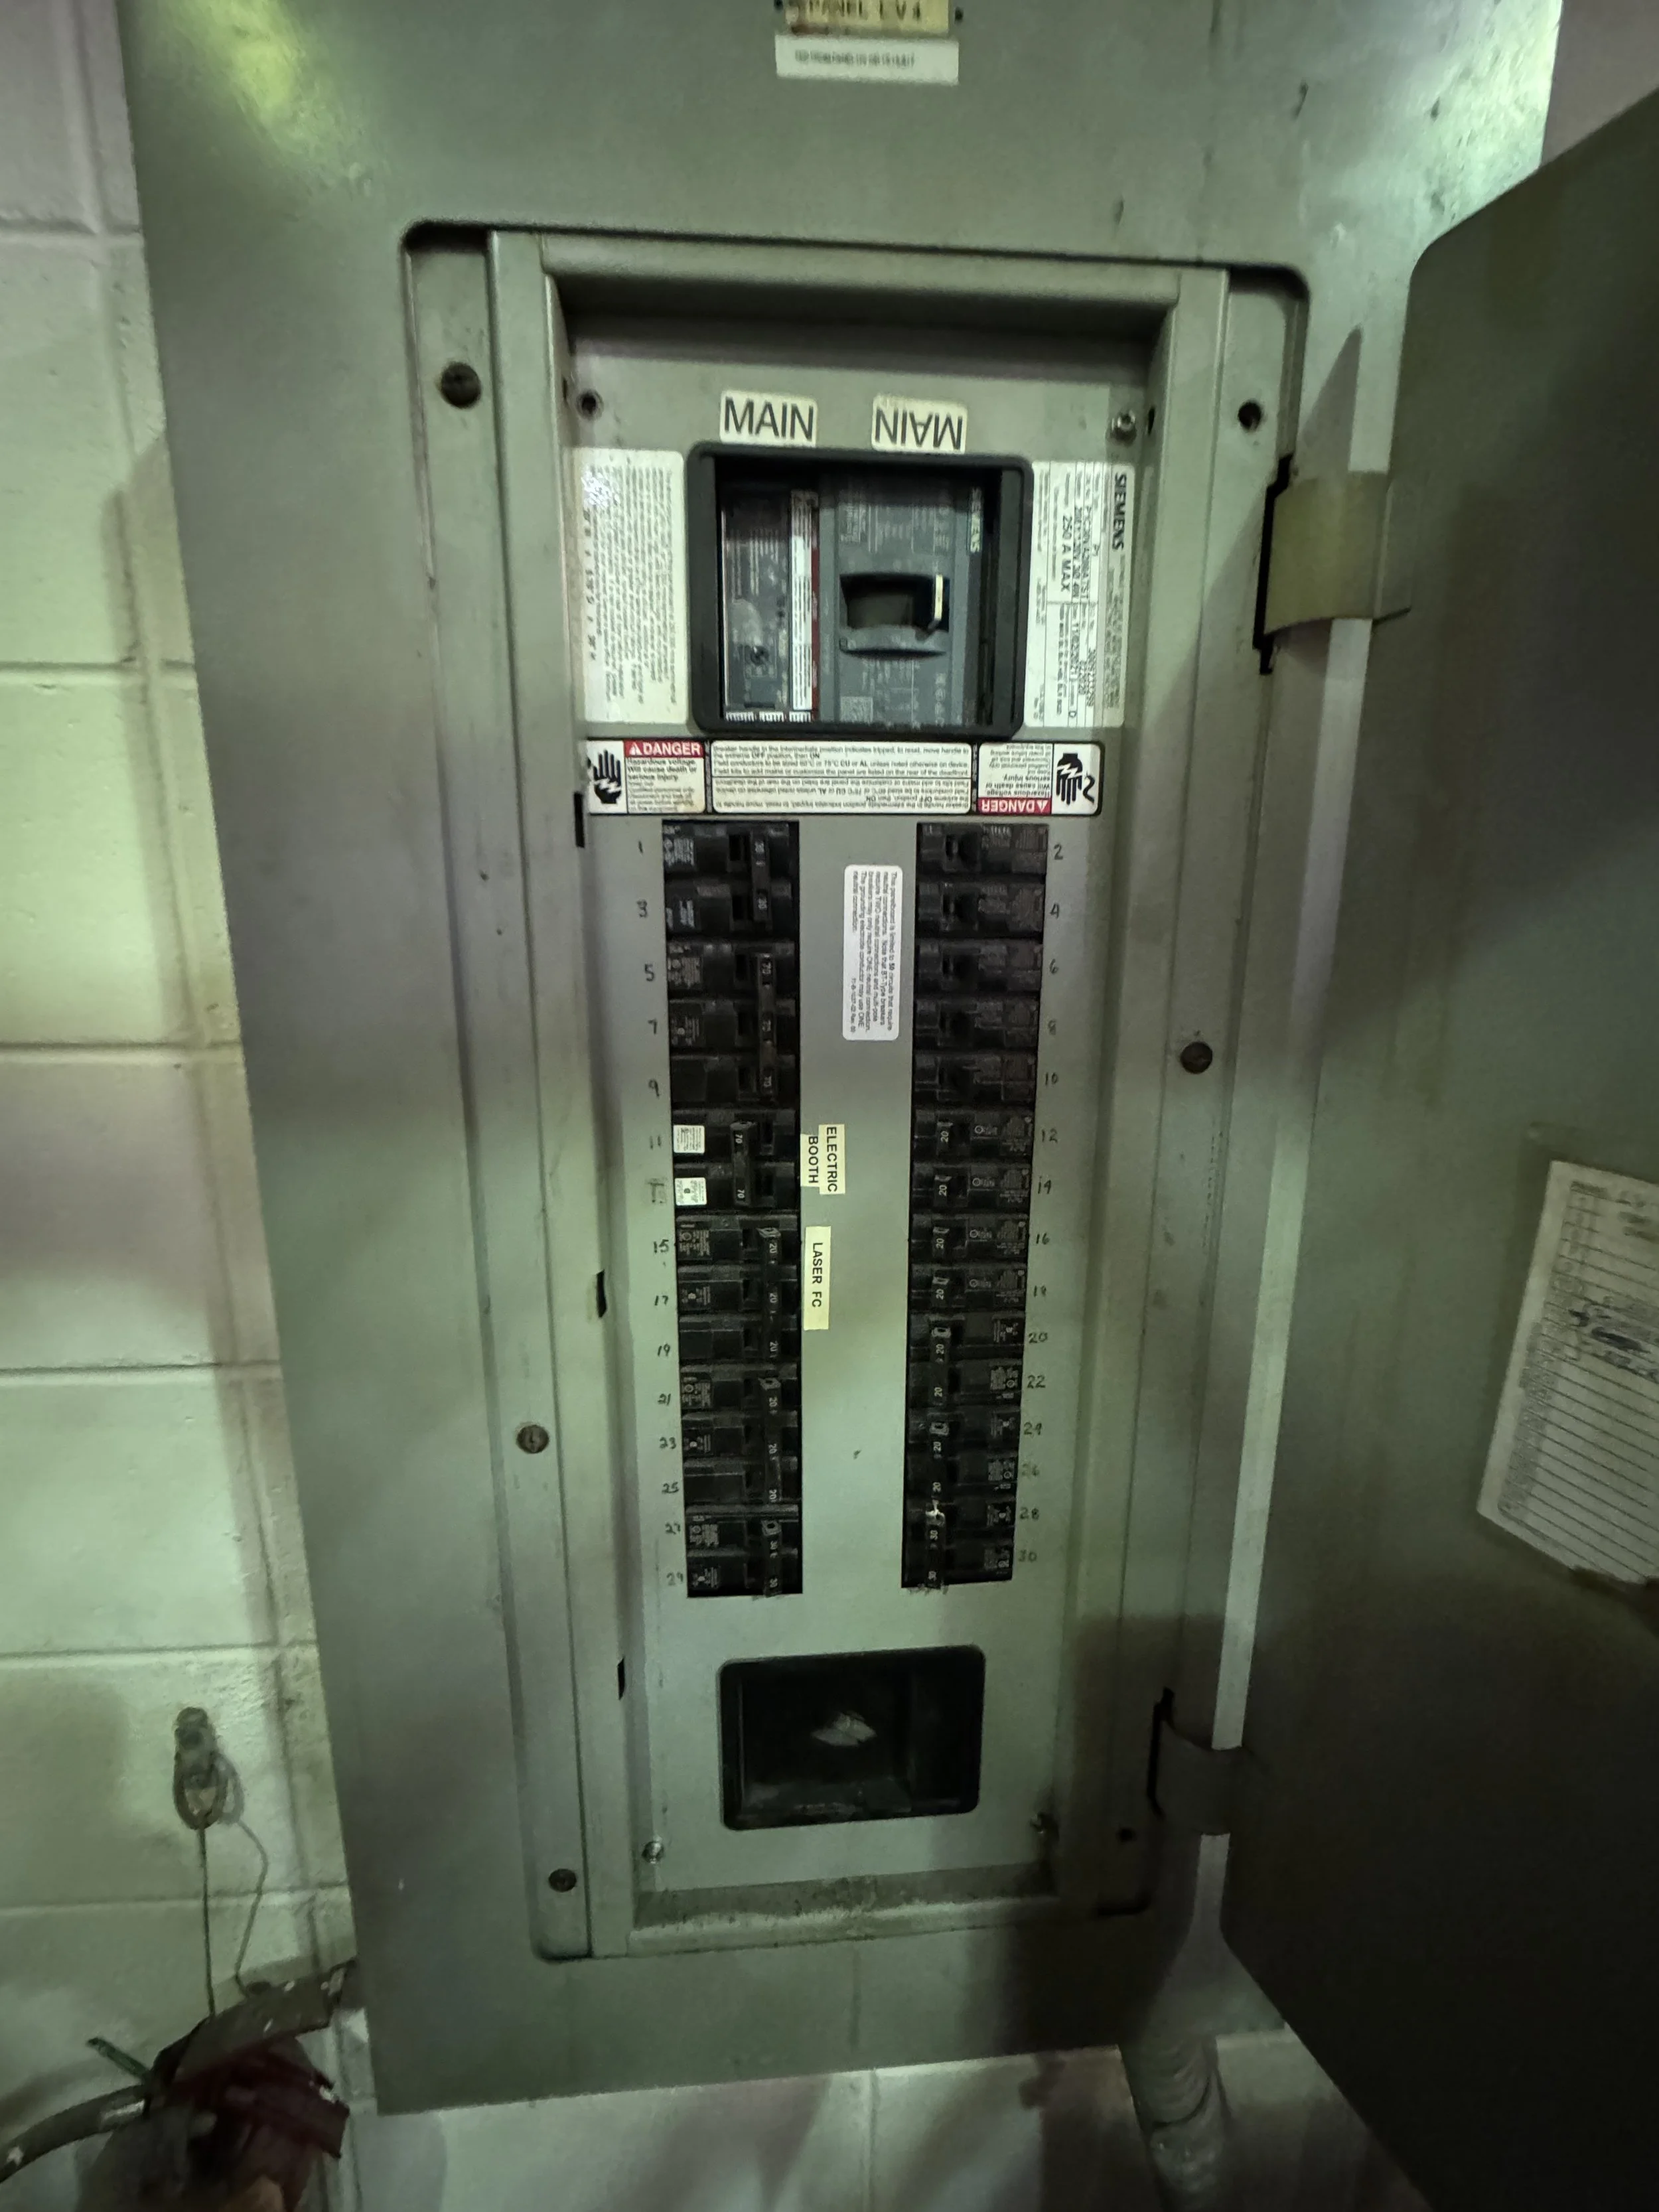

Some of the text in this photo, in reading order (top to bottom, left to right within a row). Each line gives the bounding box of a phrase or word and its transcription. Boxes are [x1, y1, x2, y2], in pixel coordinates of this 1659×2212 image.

[724, 396, 814, 441] MAIN
[874, 407, 964, 450] MAIN
[1112, 473, 1126, 550] SIEMENS
[970, 487, 981, 553] SIEMENS
[1060, 516, 1072, 591] 250 A MAX
[642, 741, 701, 755] DANGER
[981, 799, 1034, 812] DANGER
[1054, 844, 1063, 860] 2
[636, 898, 648, 918] 3
[1049, 903, 1060, 919] 4
[644, 963, 656, 982] 5
[1048, 958, 1058, 974] 6
[648, 1019, 658, 1035] 7
[1045, 1072, 1058, 1085] 10
[735, 1134, 743, 1145] 70
[940, 1130, 950, 1143] 20
[1041, 1130, 1058, 1143] 12
[808, 1136, 819, 1184] BOOTH
[827, 1126, 837, 1192] ELECTRIC
[737, 1189, 745, 1199] 70
[938, 1184, 948, 1196] 20
[936, 1238, 945, 1249] 20
[1036, 1232, 1050, 1244] 16
[653, 1239, 670, 1254] 15
[768, 1242, 776, 1254] 20
[812, 1242, 823, 1308] LASER FC
[654, 1294, 669, 1307] 17
[768, 1292, 778, 1303] 20
[936, 1290, 944, 1299] 20
[1028, 1332, 1048, 1344] 20
[656, 1344, 671, 1357] 19
[936, 1343, 945, 1355] 20
[1027, 1376, 1046, 1389] 22
[657, 1393, 672, 1406] 21
[768, 1397, 778, 1407] 20
[659, 1437, 678, 1449] 23
[767, 1443, 777, 1454] 20
[933, 1441, 942, 1452] 20
[662, 1482, 680, 1495] 25
[768, 1489, 777, 1500] 20
[1018, 1549, 1037, 1563] 30
